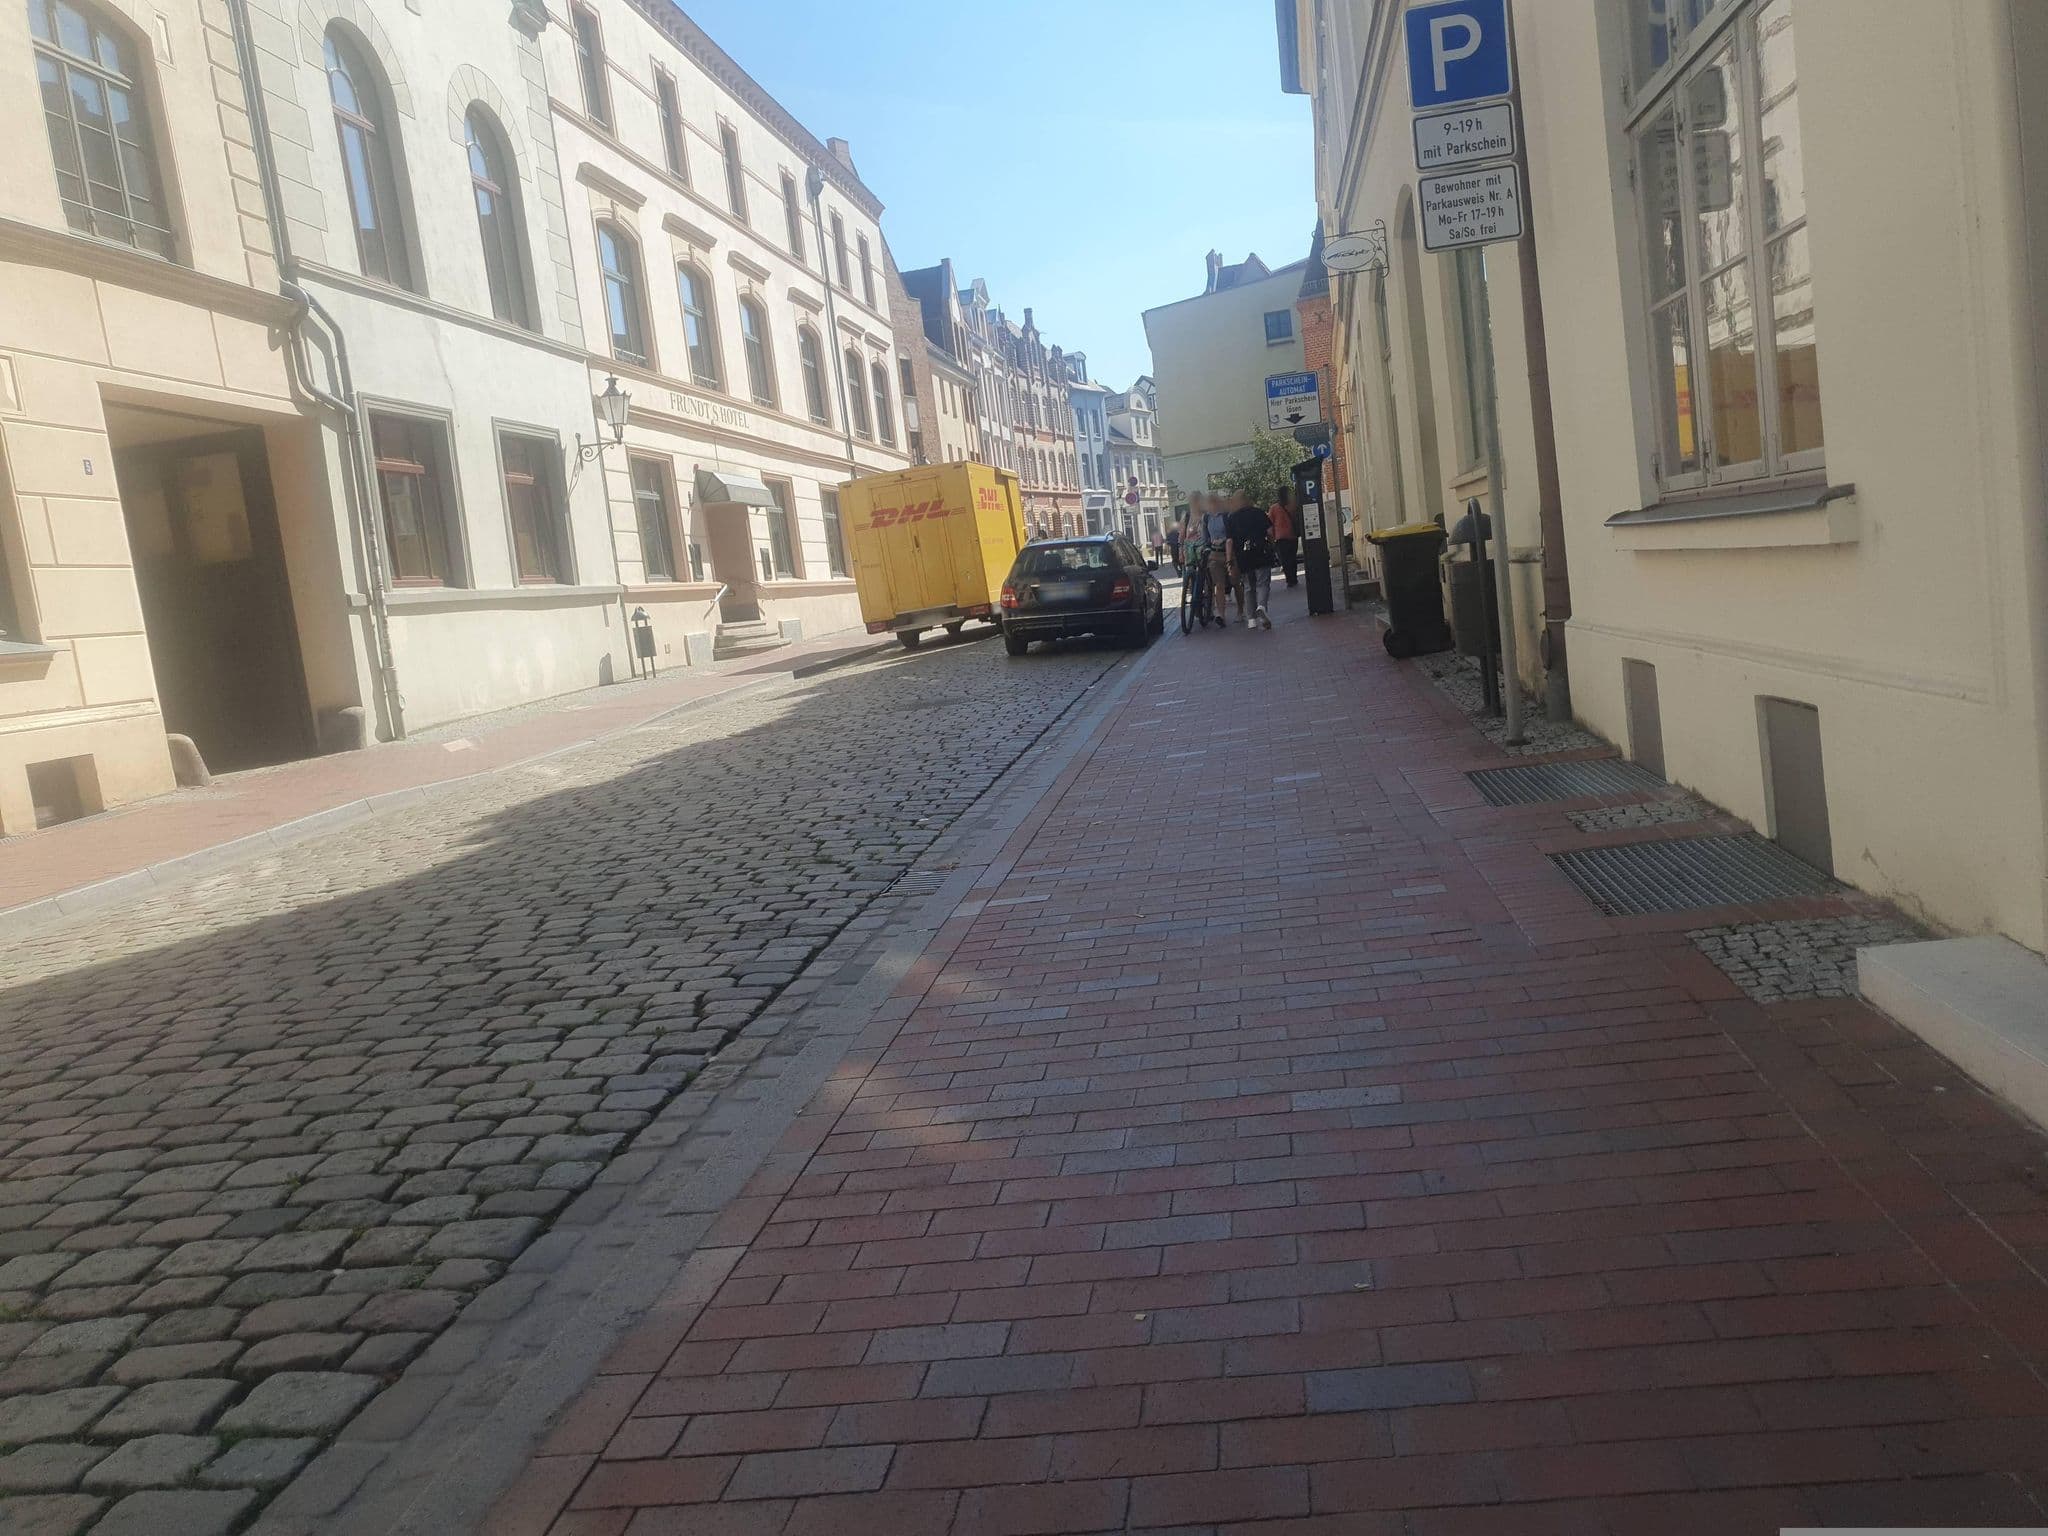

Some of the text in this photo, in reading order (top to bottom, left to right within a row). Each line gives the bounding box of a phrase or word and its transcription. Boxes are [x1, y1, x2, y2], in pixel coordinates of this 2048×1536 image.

[1430, 14, 1482, 92] P
[1423, 135, 1507, 159] mit Parkschein
[1434, 174, 1502, 194] Bewohner mit
[1426, 187, 1513, 212] Parkausweis Nr. A
[1438, 211, 1467, 226] Mo-Fr
[1449, 222, 1497, 240] Sa/So frei
[1270, 395, 1317, 407] Hier Parkschein
[720, 406, 750, 429] HOTEL
[1305, 480, 1315, 495] P
[870, 499, 951, 529] DHL
